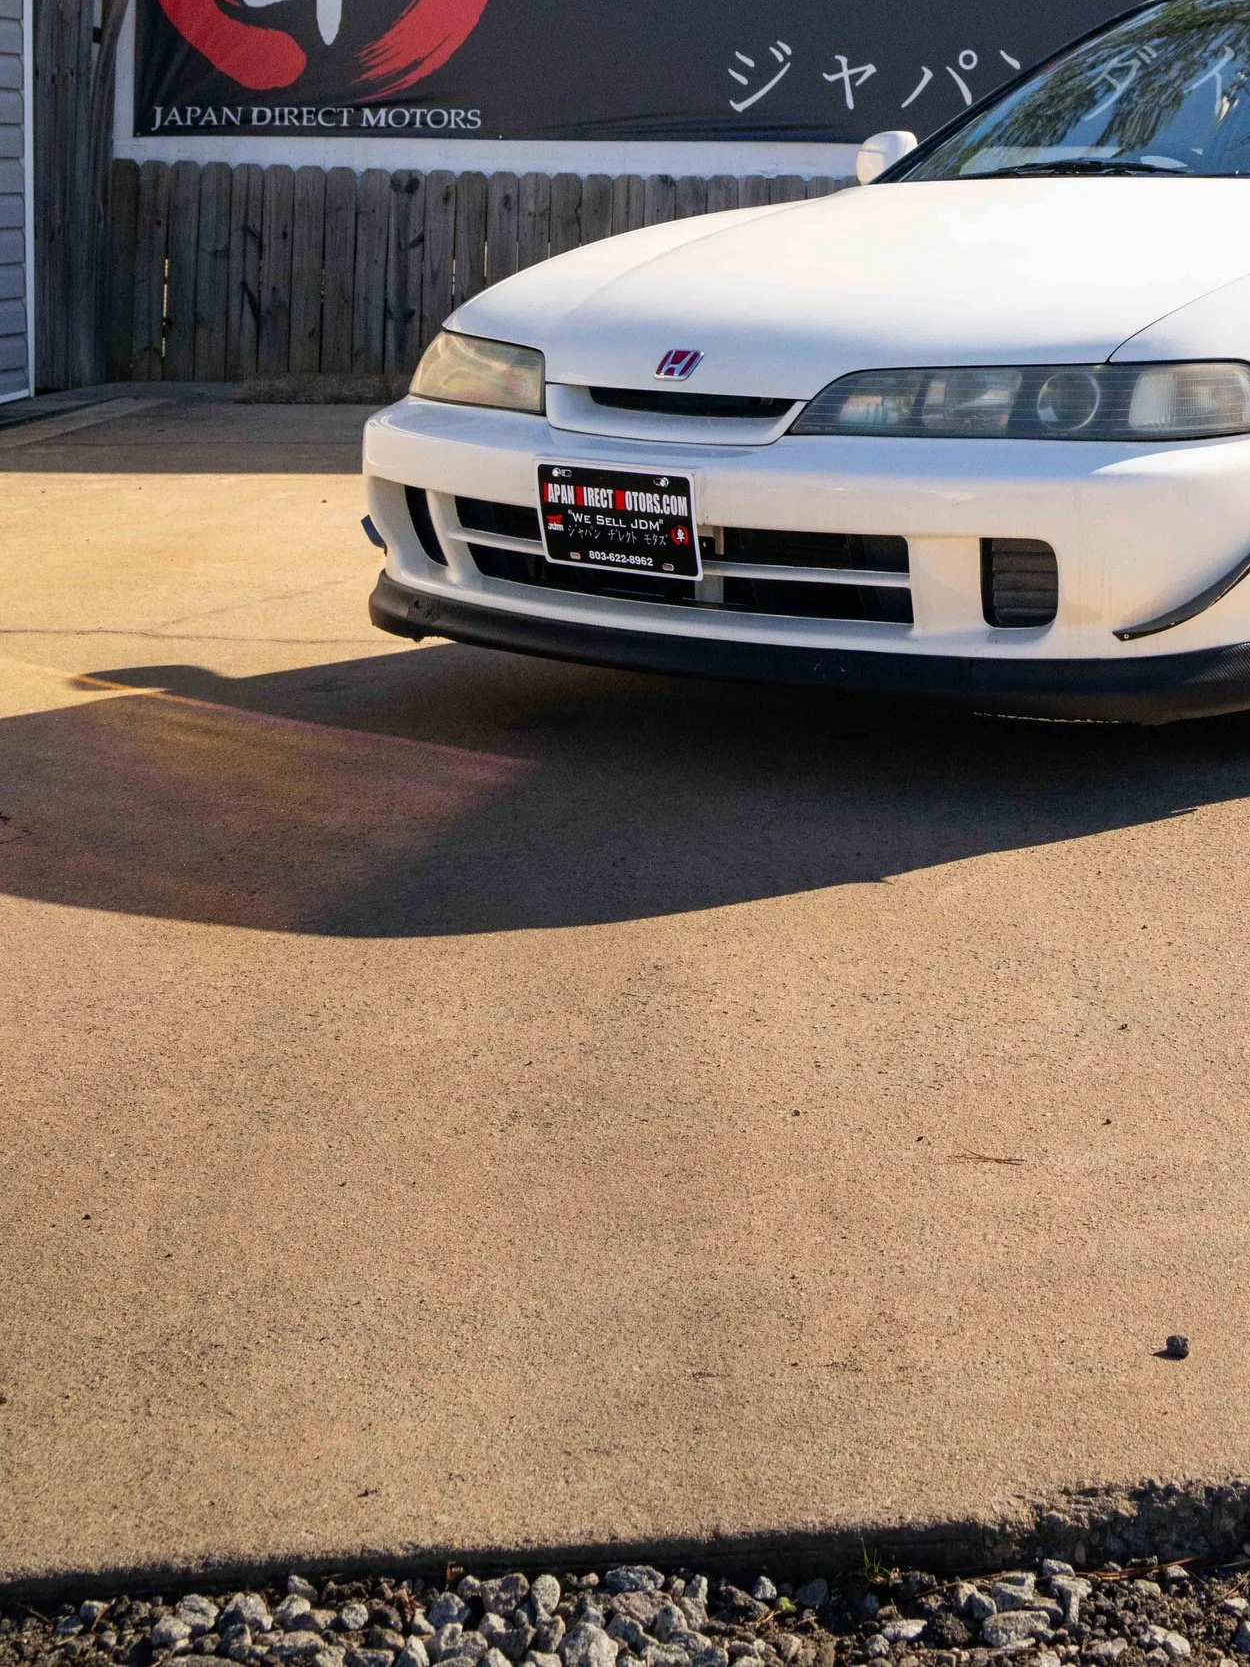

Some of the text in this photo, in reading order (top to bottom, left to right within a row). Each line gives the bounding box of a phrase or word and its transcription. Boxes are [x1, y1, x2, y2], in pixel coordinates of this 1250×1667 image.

[151, 105, 482, 130] JAPAN DIRECT MOTORS
[588, 550, 654, 566] 803-622-8962
